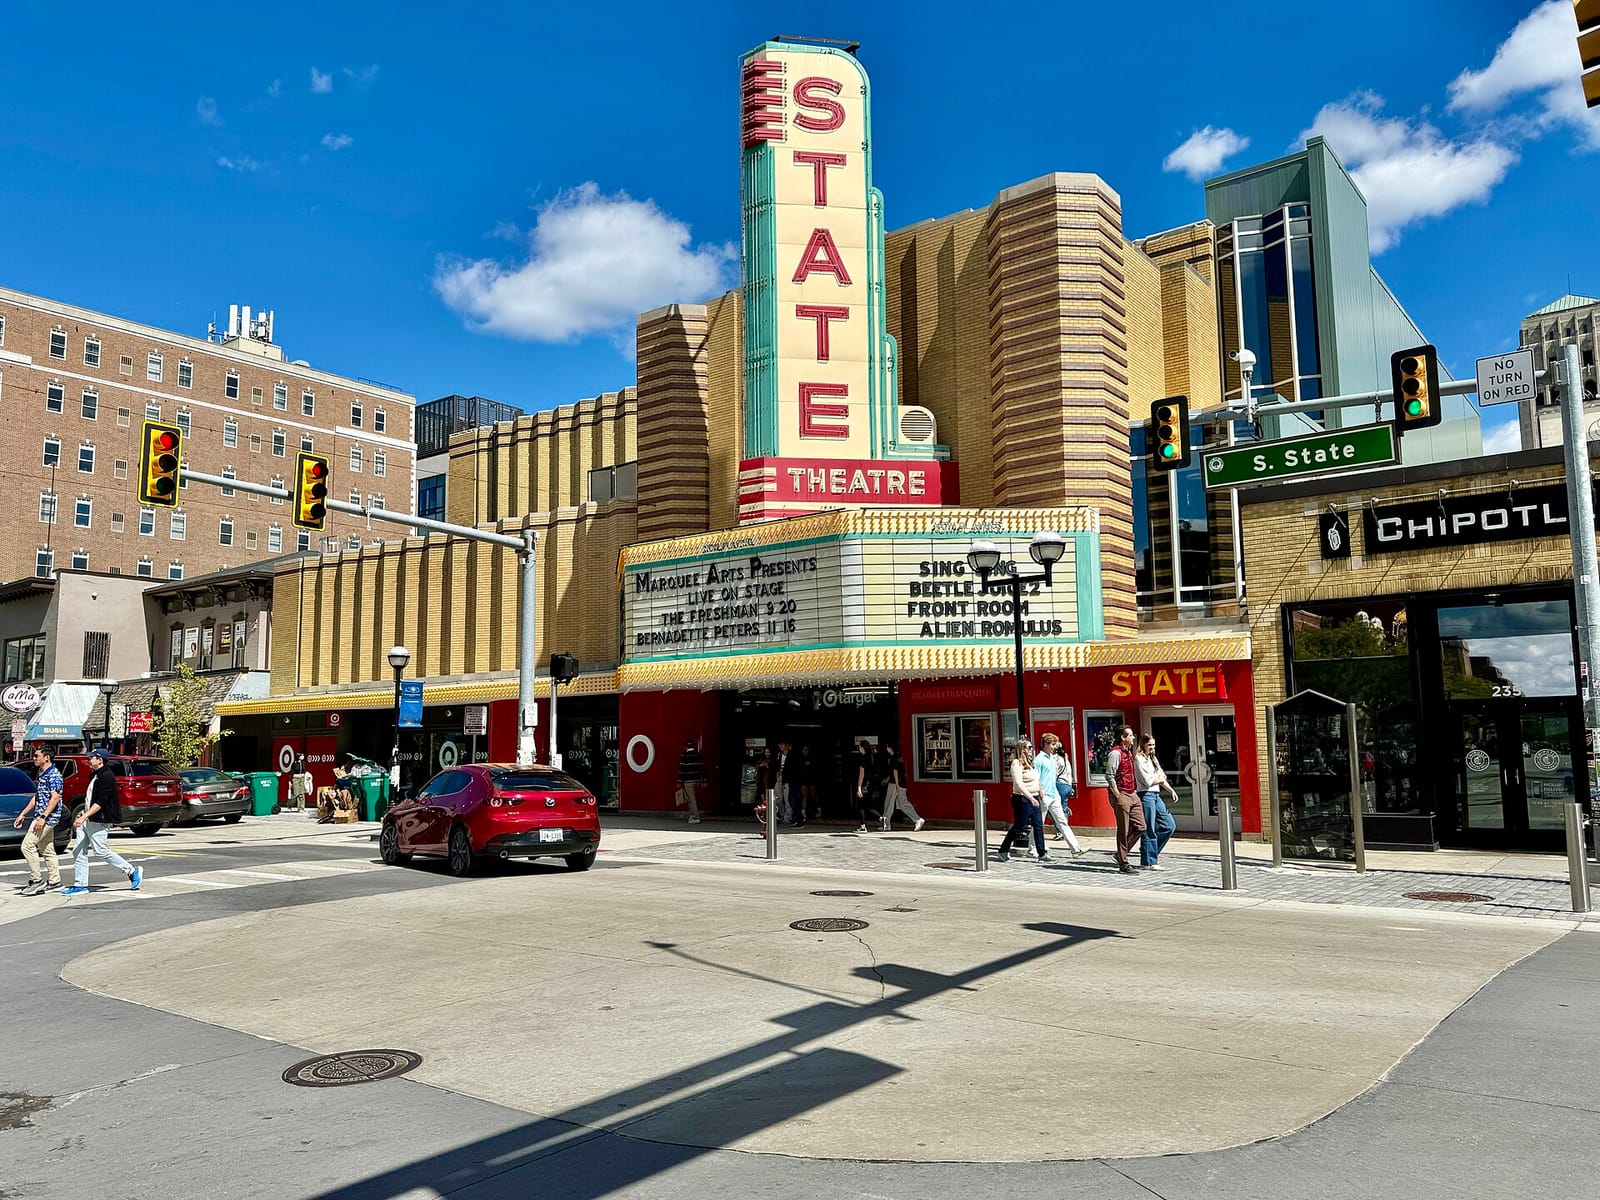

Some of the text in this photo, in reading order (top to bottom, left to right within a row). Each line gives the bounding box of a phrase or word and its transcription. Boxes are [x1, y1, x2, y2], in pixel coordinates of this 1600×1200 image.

[793, 76, 852, 439] STATE
[1494, 359, 1514, 371] NO
[1489, 371, 1522, 385] TURN
[1483, 384, 1530, 400] ON RED
[1253, 443, 1355, 472] S. State
[787, 467, 926, 496] THEATRE
[1377, 503, 1567, 542] CHIPOTL
[919, 560, 966, 577] SING
[688, 581, 785, 605] LIVE ON STAGE
[909, 581, 974, 597] BEETLE
[661, 599, 796, 626] THE FRESHMAN 9 20
[907, 599, 1029, 617] FRONT ROOM
[637, 618, 796, 646] BERNADETTE PETERS 11 16
[920, 619, 1062, 638] ALIEN ROMULUS
[1111, 667, 1217, 697] STATE
[1492, 686, 1521, 697] 235
[839, 690, 876, 707] target
